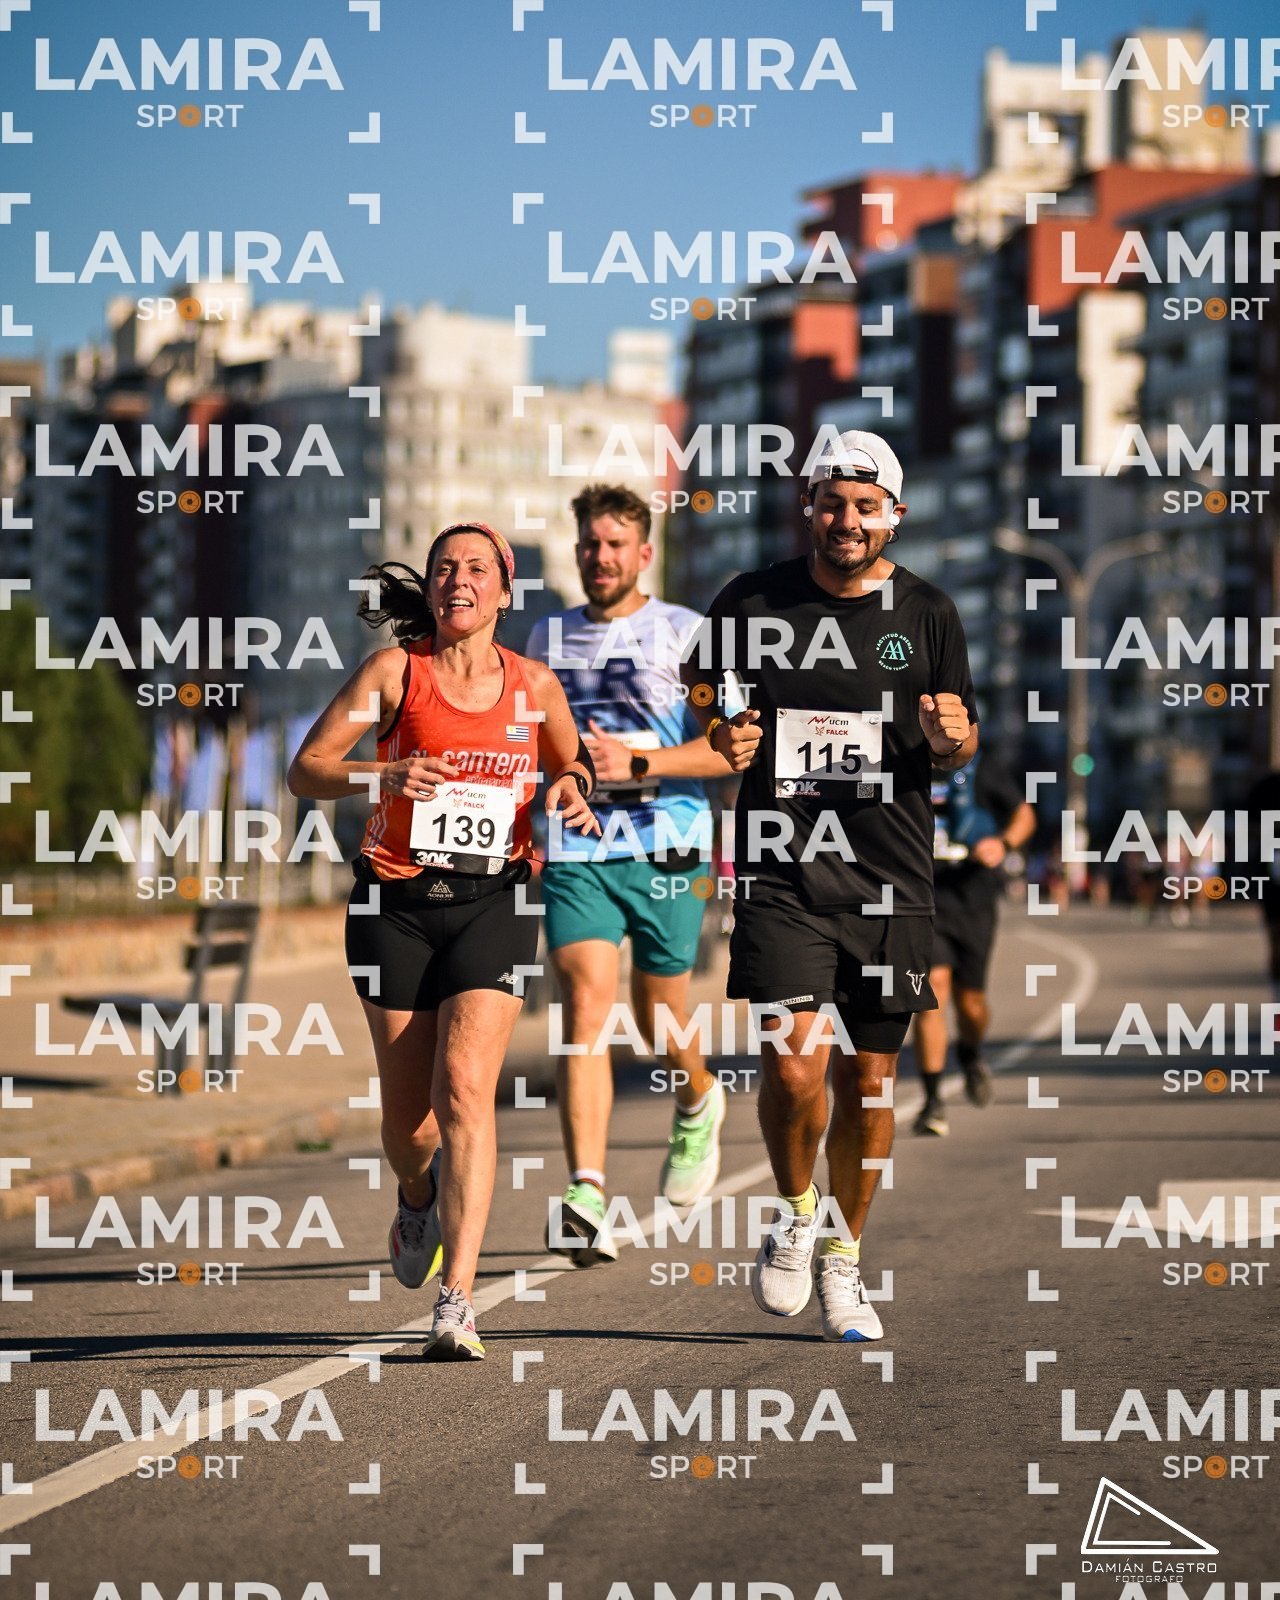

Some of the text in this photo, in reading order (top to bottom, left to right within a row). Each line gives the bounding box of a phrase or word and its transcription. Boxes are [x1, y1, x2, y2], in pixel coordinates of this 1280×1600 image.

[797, 742, 862, 775] 115
[782, 779, 818, 796] 30K
[432, 813, 495, 848] 139
[415, 851, 452, 865] 30K
